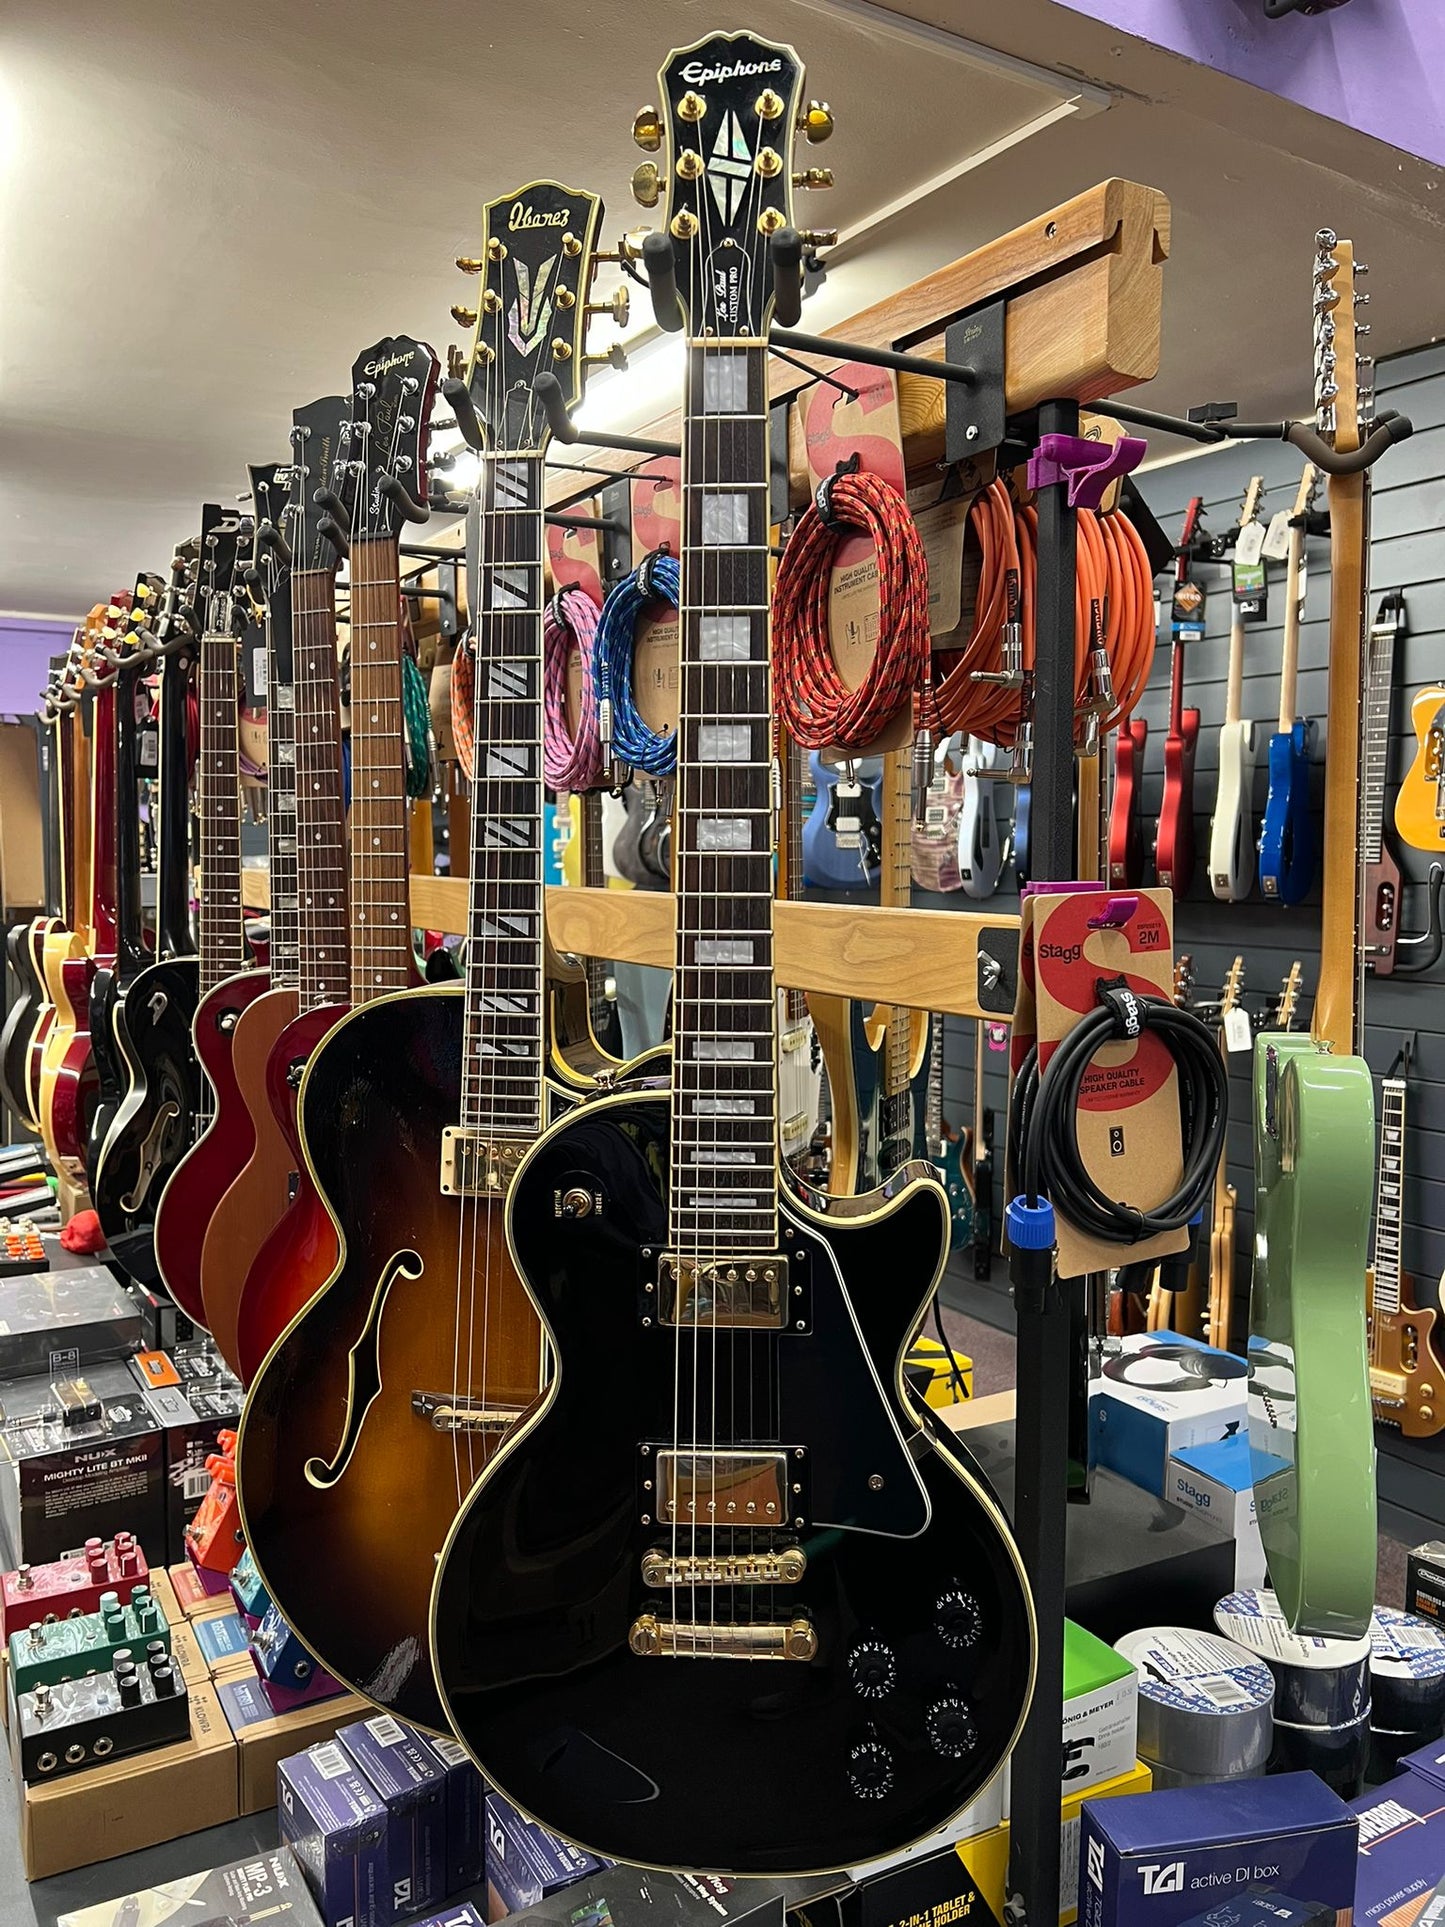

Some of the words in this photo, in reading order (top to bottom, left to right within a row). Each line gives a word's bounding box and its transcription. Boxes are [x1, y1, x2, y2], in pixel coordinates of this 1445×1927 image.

[678, 58, 782, 87] Epiphone
[508, 201, 571, 232] Ibanez
[729, 266, 738, 284] PRO
[729, 286, 738, 323] CUSTOM
[363, 350, 415, 379] Epiphone
[867, 571, 879, 580] CAB
[1138, 930, 1160, 945] 2M
[1039, 943, 1081, 965] Stagg
[1079, 1081, 1118, 1095] SPEAKER
[1118, 1077, 1146, 1088] CABLE
[1083, 1073, 1105, 1084] HIGH
[1106, 1067, 1140, 1080] QUALITY
[43, 1466, 85, 1482] MIGHTY
[86, 1461, 108, 1473] LITE
[110, 1458, 124, 1468] BT
[125, 1453, 149, 1466] MKII
[1177, 1478, 1211, 1508] Stagg
[1231, 1668, 1264, 1685] EAGLE
[1062, 1713, 1082, 1725] ÖNIG
[1082, 1710, 1089, 1719] &
[1088, 1699, 1115, 1716] MEYER
[1167, 1694, 1201, 1713] EAGLE
[195, 1703, 212, 1735] KLOWRA
[1358, 1799, 1427, 1855] OWERBOX
[243, 1861, 273, 1898] MP-3
[1137, 1861, 1185, 1896] TGI
[1190, 1871, 1232, 1890] active
[1235, 1867, 1250, 1883] DI
[1253, 1864, 1281, 1881] box
[707, 1895, 729, 1917] System
[931, 1893, 967, 1918] TABLET
[967, 1890, 976, 1903] &
[1364, 1901, 1387, 1918] micro
[1385, 1889, 1406, 1908] power
[1404, 1876, 1428, 1896] supply
[933, 1903, 971, 1927] HOLDER
